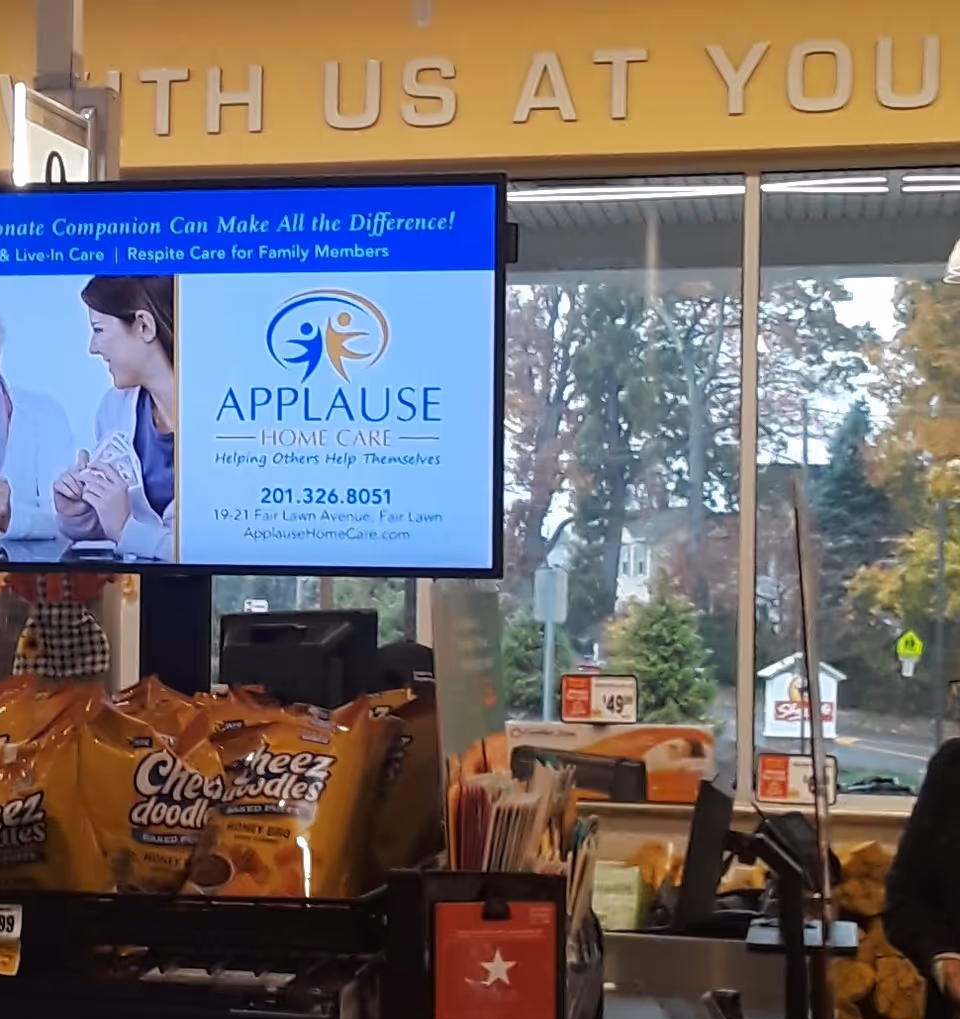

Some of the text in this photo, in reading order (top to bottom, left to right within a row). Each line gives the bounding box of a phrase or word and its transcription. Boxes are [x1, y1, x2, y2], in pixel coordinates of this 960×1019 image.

[323, 57, 457, 130] US
[512, 48, 648, 124] AT
[705, 34, 939, 116] YOU
[52, 217, 161, 240] Companion
[170, 216, 208, 234] Can
[216, 214, 269, 233] Make
[277, 213, 305, 232] All
[311, 213, 341, 232] the
[349, 210, 455, 237] Difference!
[0, 248, 10, 262] &
[16, 247, 64, 262] Live-In
[69, 247, 104, 262] Care
[128, 246, 184, 266] Respite
[190, 246, 226, 260] Care
[231, 244, 253, 260] for
[259, 244, 309, 262] Family
[315, 244, 389, 259] Members
[216, 386, 442, 422] APPLAUSE
[261, 429, 392, 447] HOME CARE
[215, 452, 441, 469] Helping Others Help Themselves
[260, 487, 392, 505] 201.326.8051
[213, 508, 443, 523] 19-21 Fair Lawn Fair Lawn
[243, 526, 411, 543] ApplauseHomeCare.com
